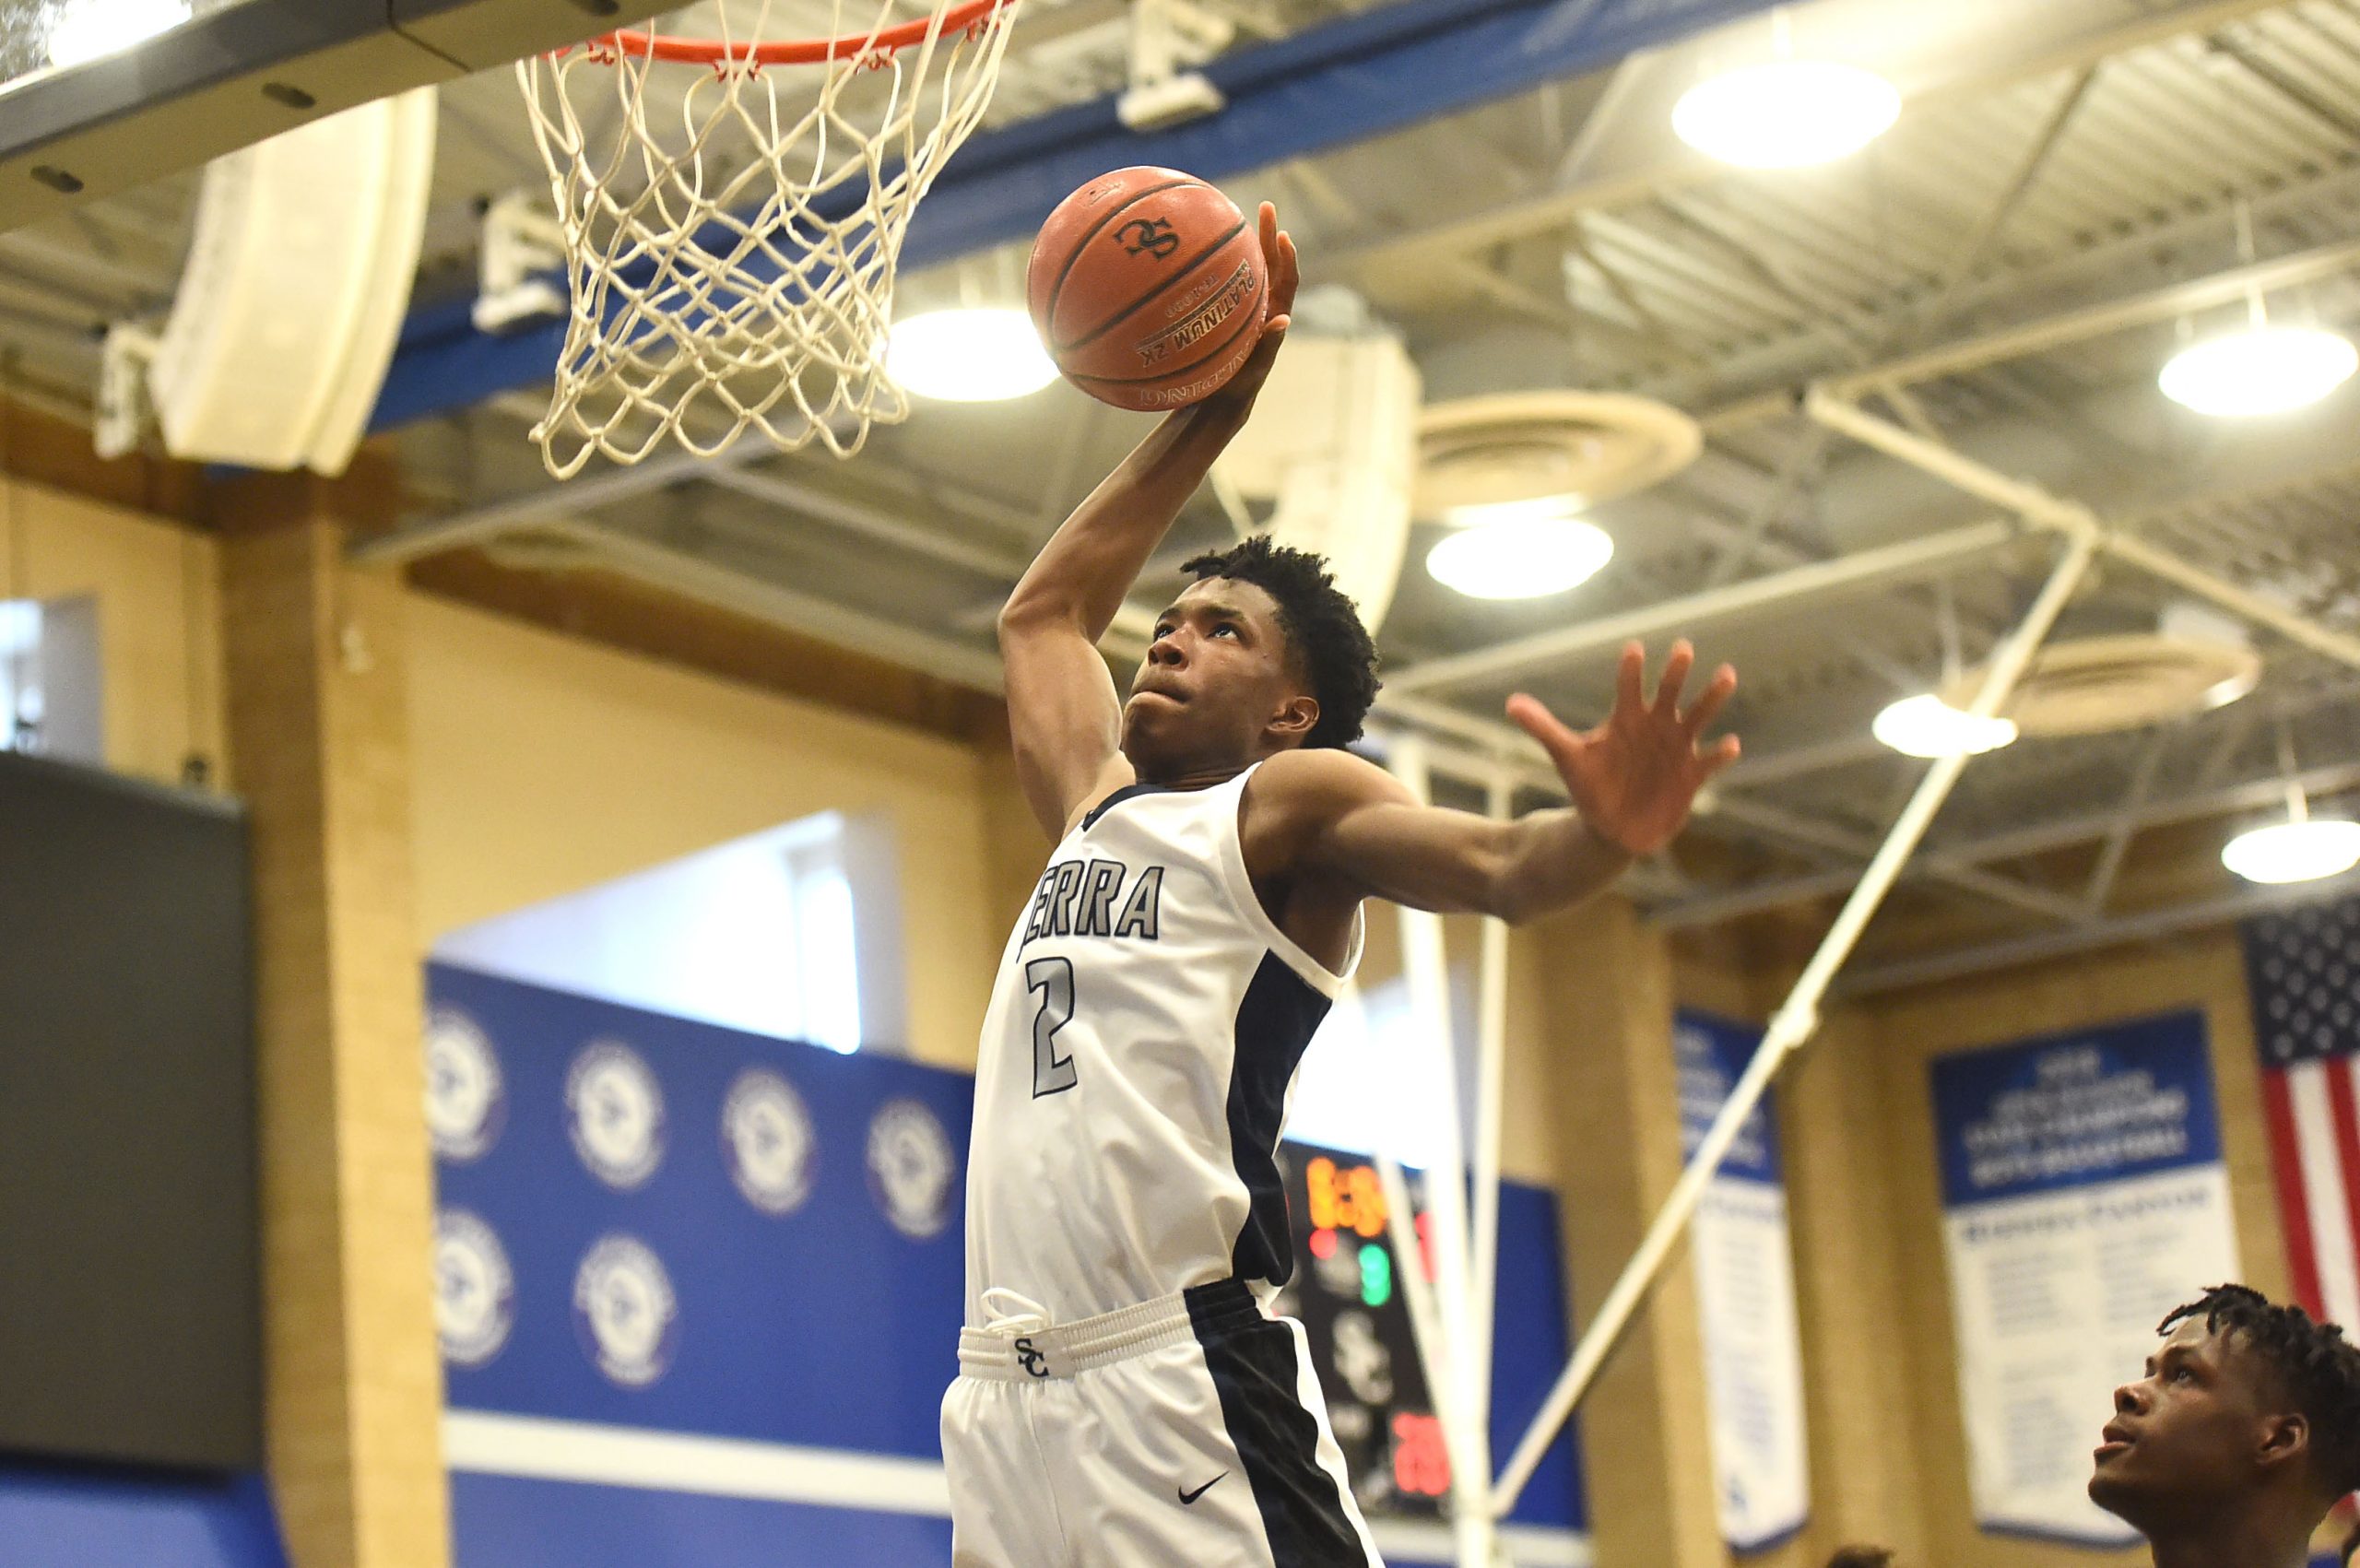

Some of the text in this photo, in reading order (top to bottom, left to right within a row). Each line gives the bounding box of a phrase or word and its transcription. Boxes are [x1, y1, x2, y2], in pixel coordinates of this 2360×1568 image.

[1137, 265, 1256, 369] PLATINUM 2K
[1019, 858, 1165, 949] ERRA
[1024, 955, 1079, 1100] 2
[1014, 1338, 1050, 1378] SC
